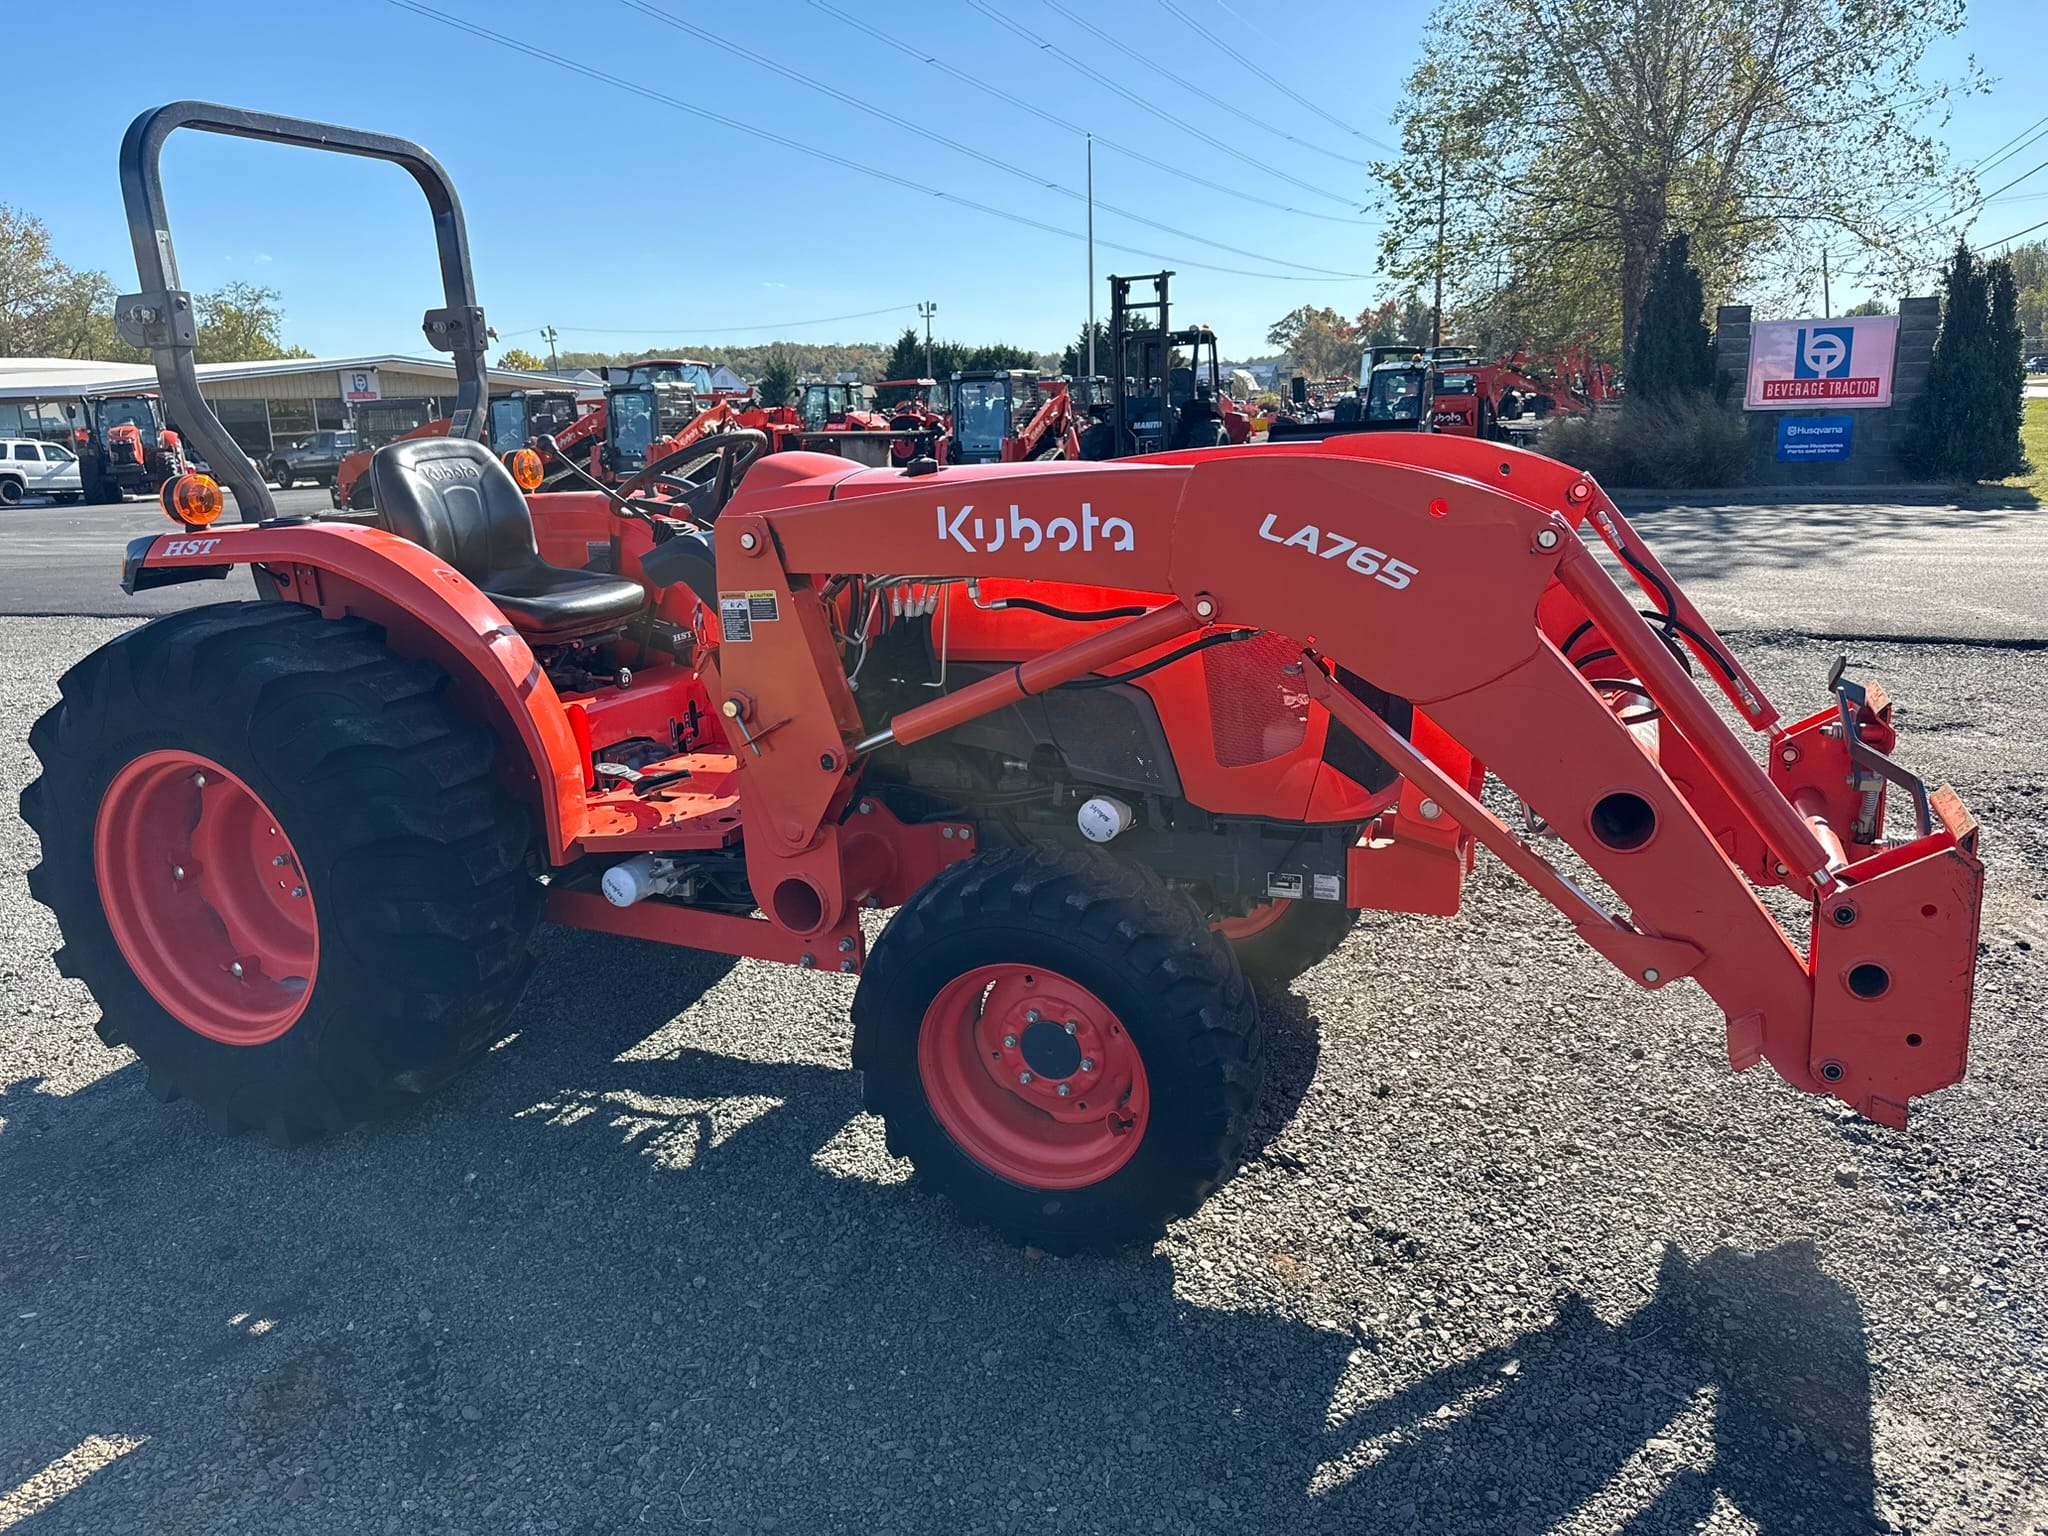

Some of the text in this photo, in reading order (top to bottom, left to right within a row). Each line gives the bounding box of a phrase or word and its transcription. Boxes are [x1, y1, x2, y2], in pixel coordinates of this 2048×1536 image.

[1766, 380, 1877, 397] BEVERAGE TRACTOR
[1797, 426, 1843, 435] Husqvarna
[420, 461, 480, 481] Kubota
[937, 503, 1135, 553] Kubota
[162, 539, 221, 557] HST
[1258, 513, 1419, 590] LA765
[672, 631, 692, 642] HST
